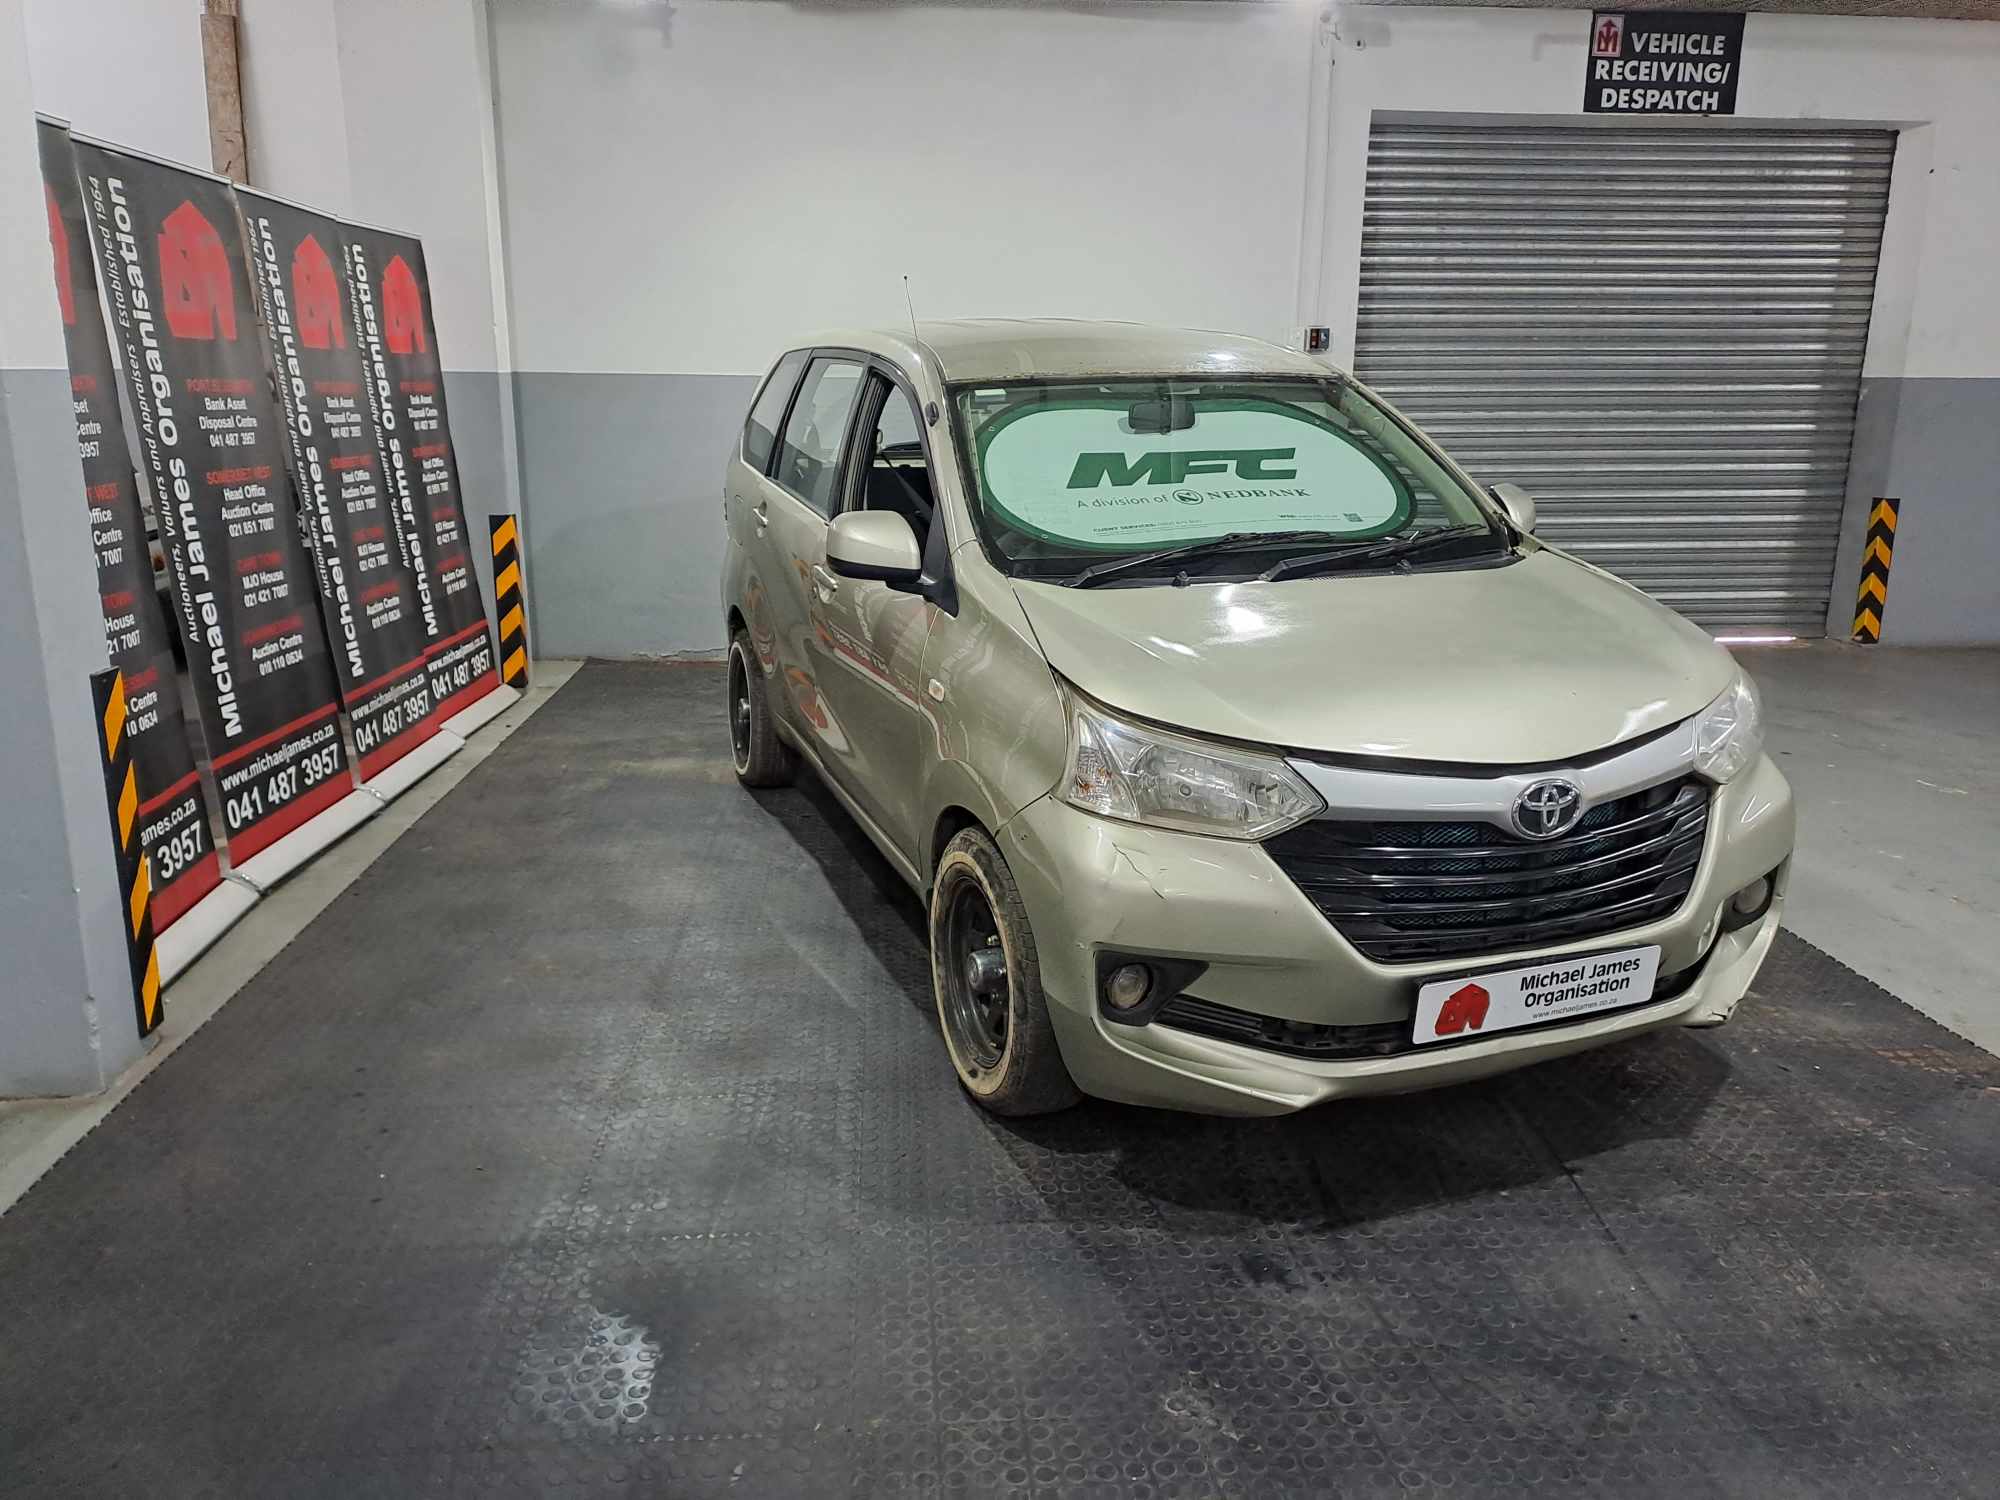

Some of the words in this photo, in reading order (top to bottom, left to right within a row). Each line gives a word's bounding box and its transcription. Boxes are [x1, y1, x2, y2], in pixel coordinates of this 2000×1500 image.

[1631, 32, 1726, 55] VEHICLE
[1595, 60, 1731, 84] RECEIVING/
[1600, 88, 1720, 111] DESPATCH
[88, 175, 106, 221] 1964
[98, 224, 131, 329] Established
[108, 177, 178, 446] Organisation
[258, 217, 313, 438] Organisation
[352, 243, 396, 431] Organisation
[126, 342, 155, 435] Appraisers
[77, 420, 102, 436] entre
[199, 415, 236, 432] Disposal
[79, 441, 99, 458] 3957
[145, 437, 162, 471] and
[1066, 447, 1297, 489] MFC
[305, 446, 337, 549] James
[389, 438, 416, 525] James
[1077, 499, 1090, 509] A
[1091, 493, 1150, 508] division
[1153, 494, 1168, 504] of
[1207, 488, 1312, 501] NEDBANK
[156, 475, 178, 537] Valuers
[169, 458, 210, 581] James
[221, 504, 252, 521] Auction
[93, 529, 124, 546] Centre
[101, 548, 123, 567] 7007
[172, 543, 200, 643] Auctioneers,
[406, 532, 440, 637] Michael
[104, 614, 135, 633] House
[327, 556, 365, 678] Michael
[120, 629, 141, 650] 7007
[252, 642, 280, 661] Auction
[195, 592, 243, 738] Michael
[431, 671, 454, 701] 041
[453, 660, 471, 689] 487
[470, 647, 492, 677] 3957
[130, 689, 158, 714] Centre
[138, 708, 159, 732] 0634
[355, 718, 382, 754] 041
[382, 703, 404, 738] 487
[403, 688, 431, 723] 3957
[221, 723, 335, 792] www.michaeljames.co.za
[226, 785, 263, 829] 041
[267, 764, 298, 805] 487
[301, 742, 340, 786] 3957
[140, 797, 196, 848] ames.co.za
[157, 820, 202, 880] 3957
[1520, 966, 1586, 991] Michael
[1589, 958, 1641, 979] James
[1524, 976, 1631, 1007] Organisation
[1532, 998, 1617, 1019] www.michaeljames.co.za
